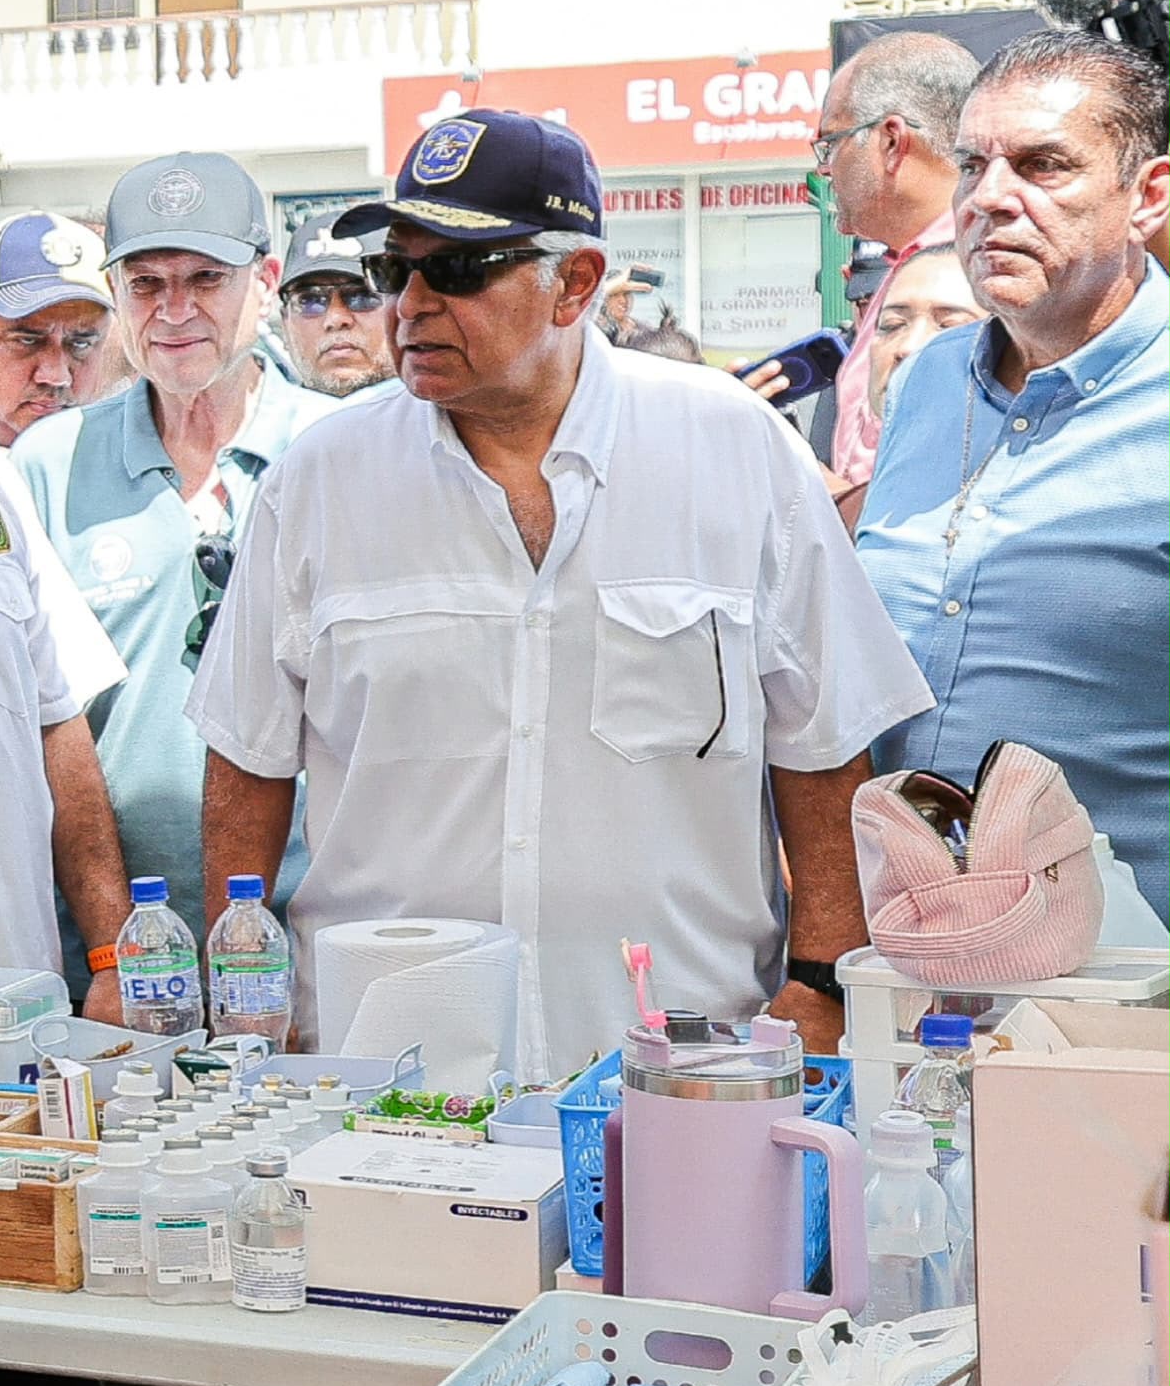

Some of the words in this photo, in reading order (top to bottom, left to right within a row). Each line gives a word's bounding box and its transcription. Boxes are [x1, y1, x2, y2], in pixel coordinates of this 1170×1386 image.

[627, 78, 691, 123] EL
[701, 184, 725, 208] DE
[730, 181, 810, 208] OFICINA
[457, 1205, 521, 1219] INYECTABLES
